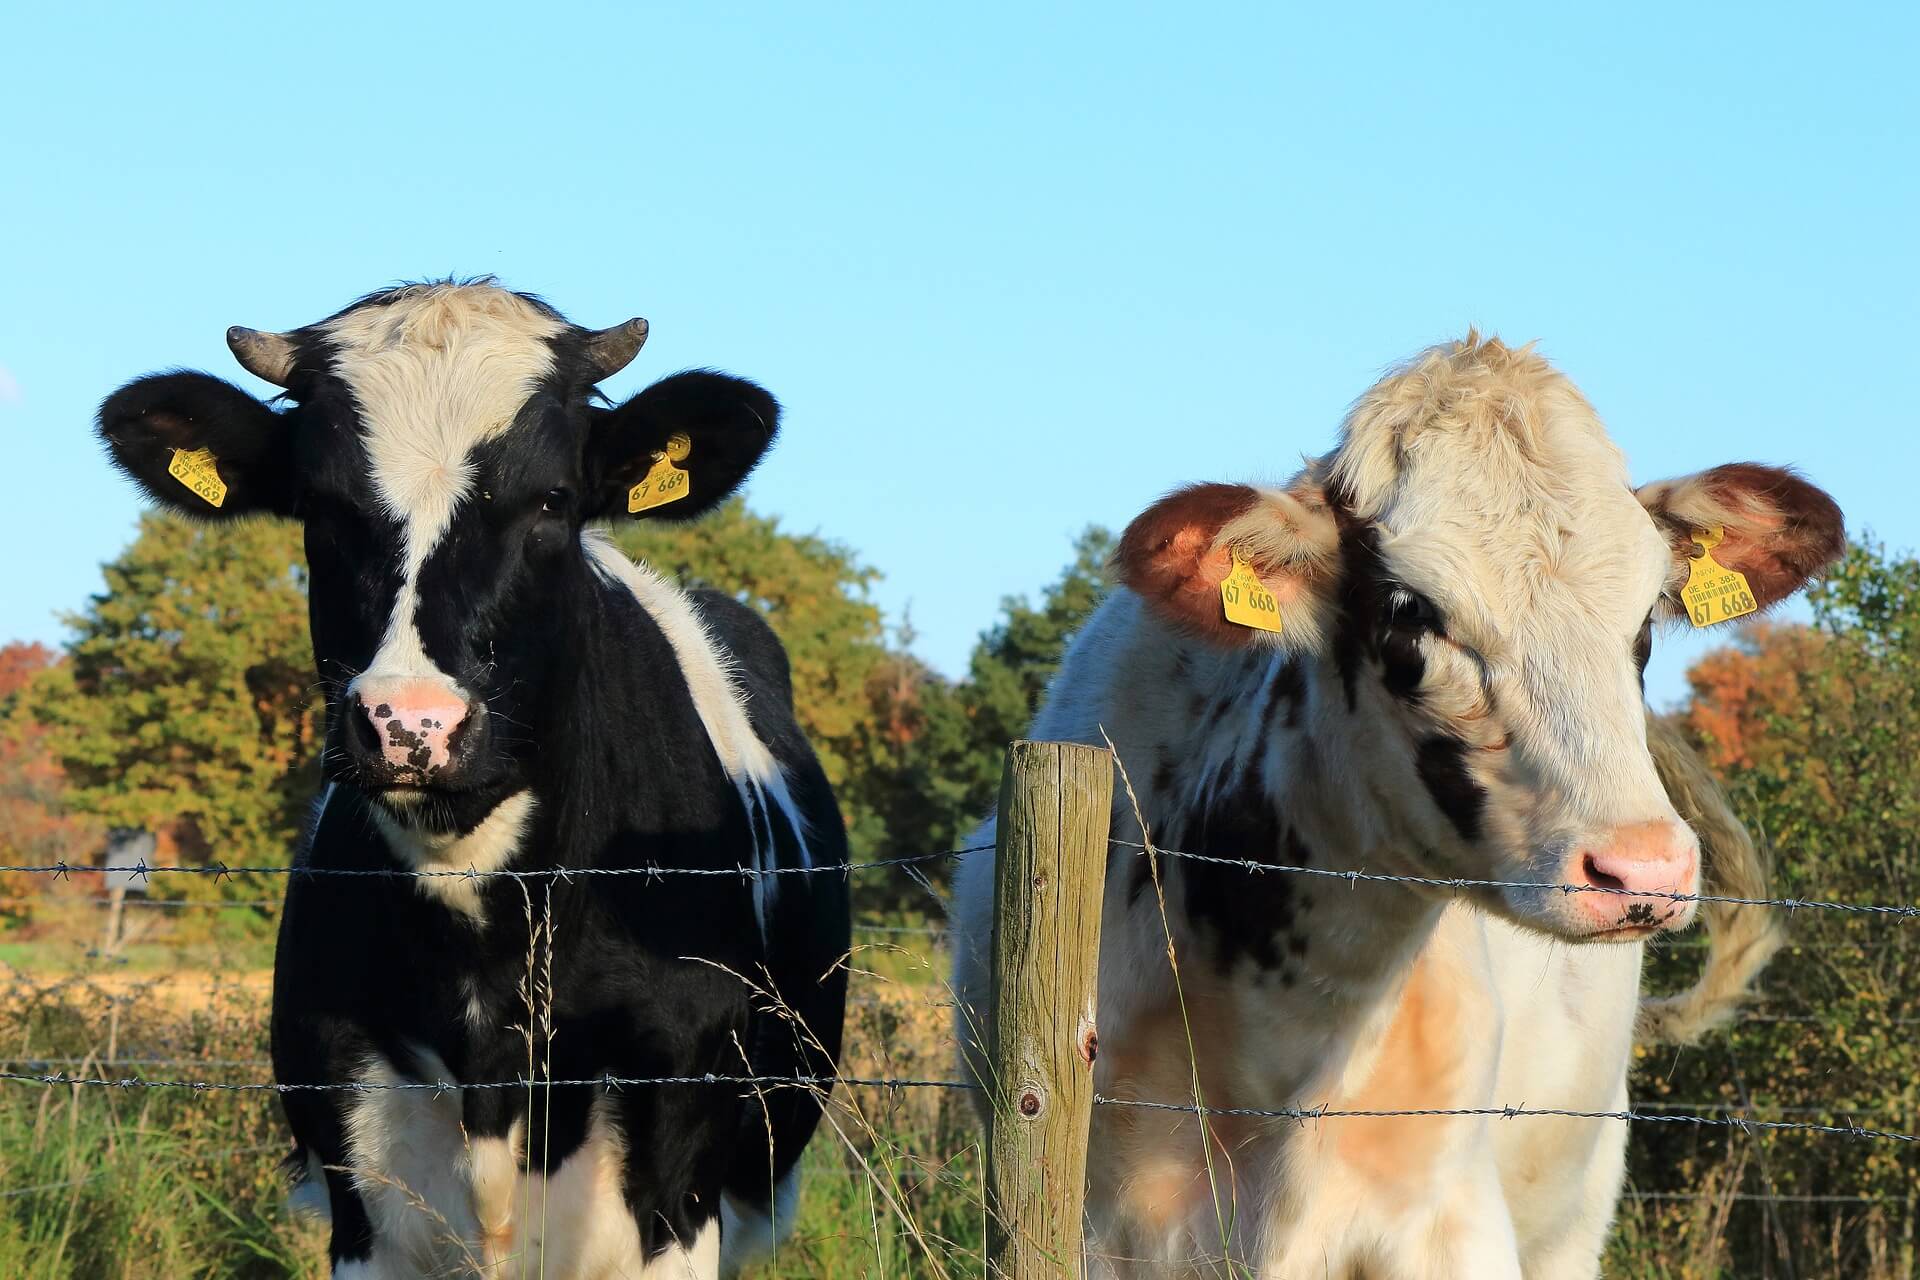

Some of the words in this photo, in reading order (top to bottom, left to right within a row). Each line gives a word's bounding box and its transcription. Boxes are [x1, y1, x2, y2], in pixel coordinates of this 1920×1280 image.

[172, 463, 190, 479] 67
[194, 481, 220, 501] 669
[632, 485, 650, 501] 67
[658, 472, 684, 492] 669
[1688, 584, 1700, 594] DE
[1703, 580, 1716, 589] 05
[1720, 573, 1736, 585] 383
[1225, 584, 1240, 605] 67
[1249, 590, 1276, 613] 668
[1693, 602, 1711, 625] 67
[1721, 591, 1752, 616] 668
